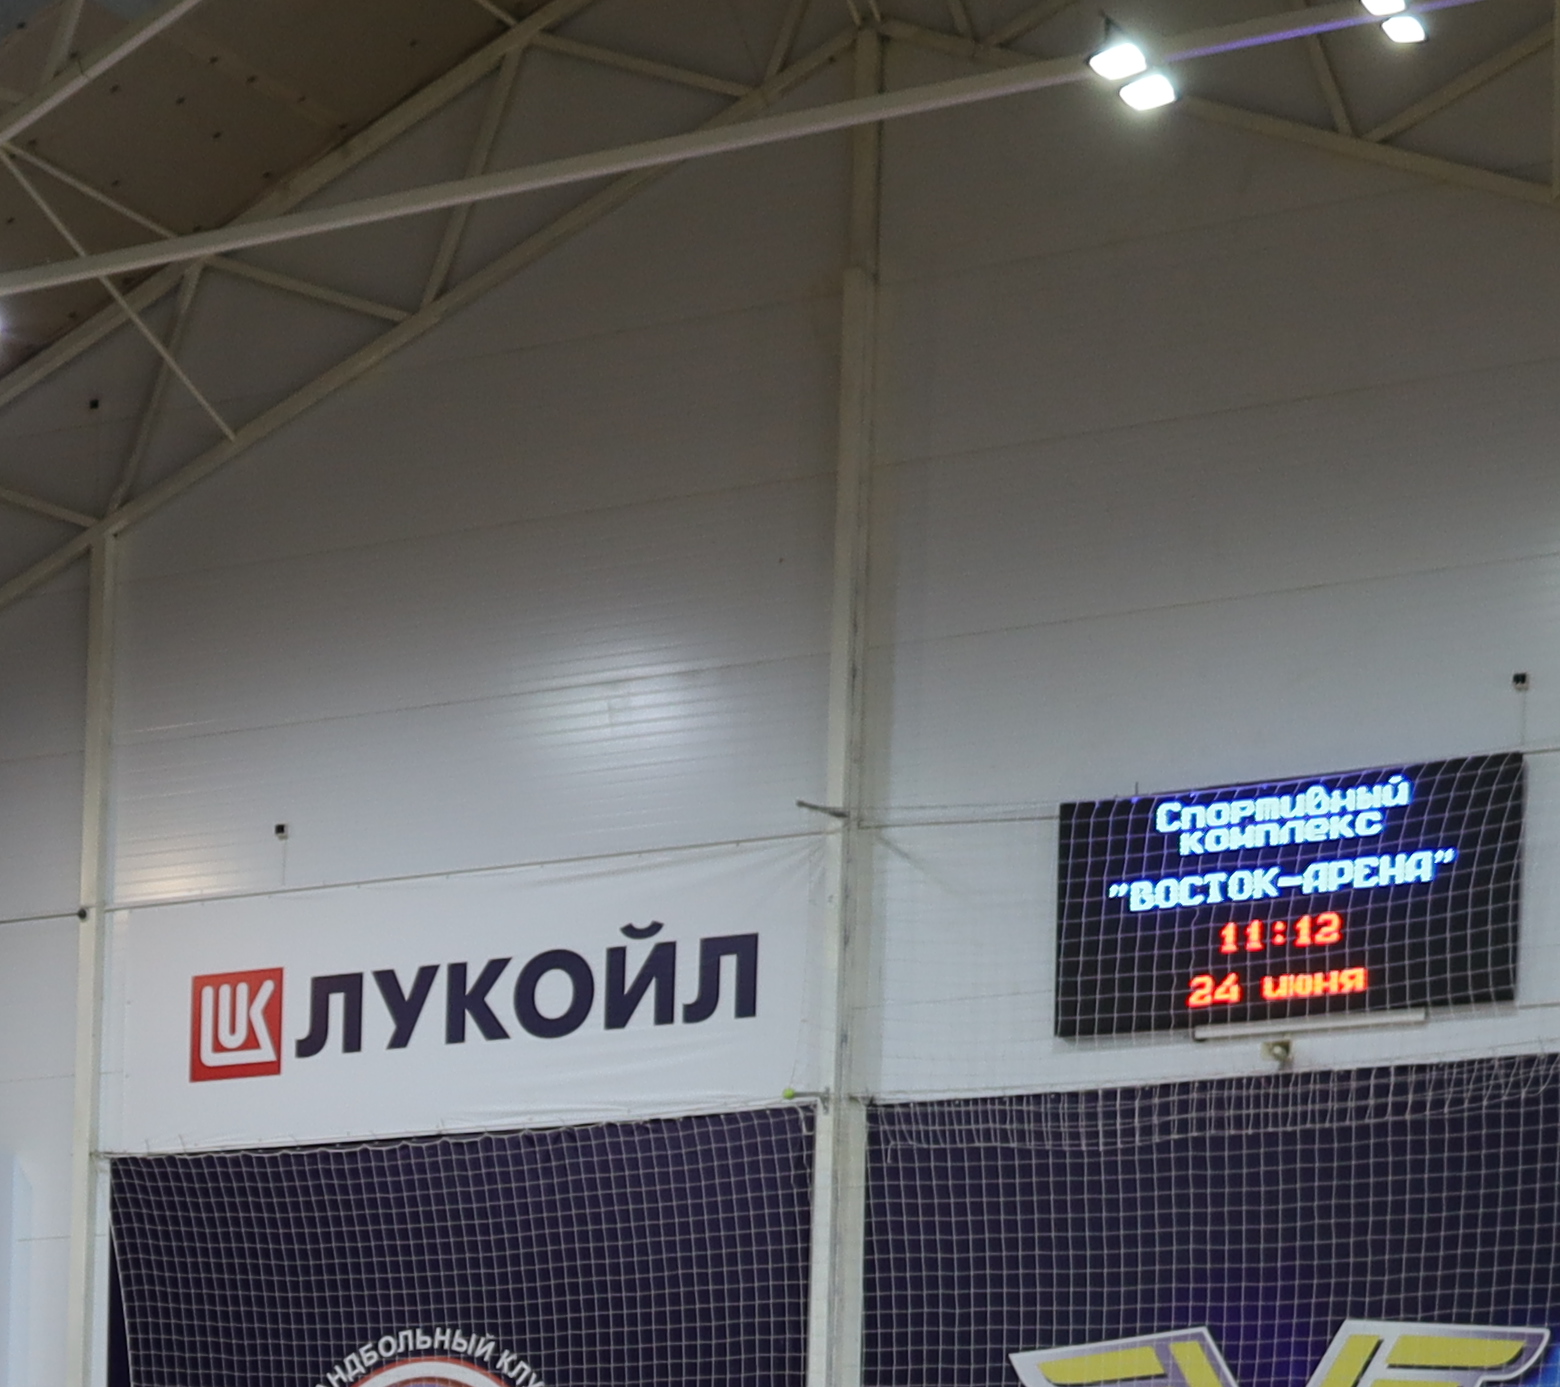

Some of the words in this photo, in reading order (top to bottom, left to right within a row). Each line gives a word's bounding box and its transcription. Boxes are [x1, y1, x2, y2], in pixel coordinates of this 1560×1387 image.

[1179, 810, 1384, 856] комплекс
[1218, 912, 1343, 954] 11:12
[295, 921, 759, 1058] ЛУКОЙЛ
[1186, 973, 1243, 1009] 24
[1261, 967, 1368, 1000] июня
